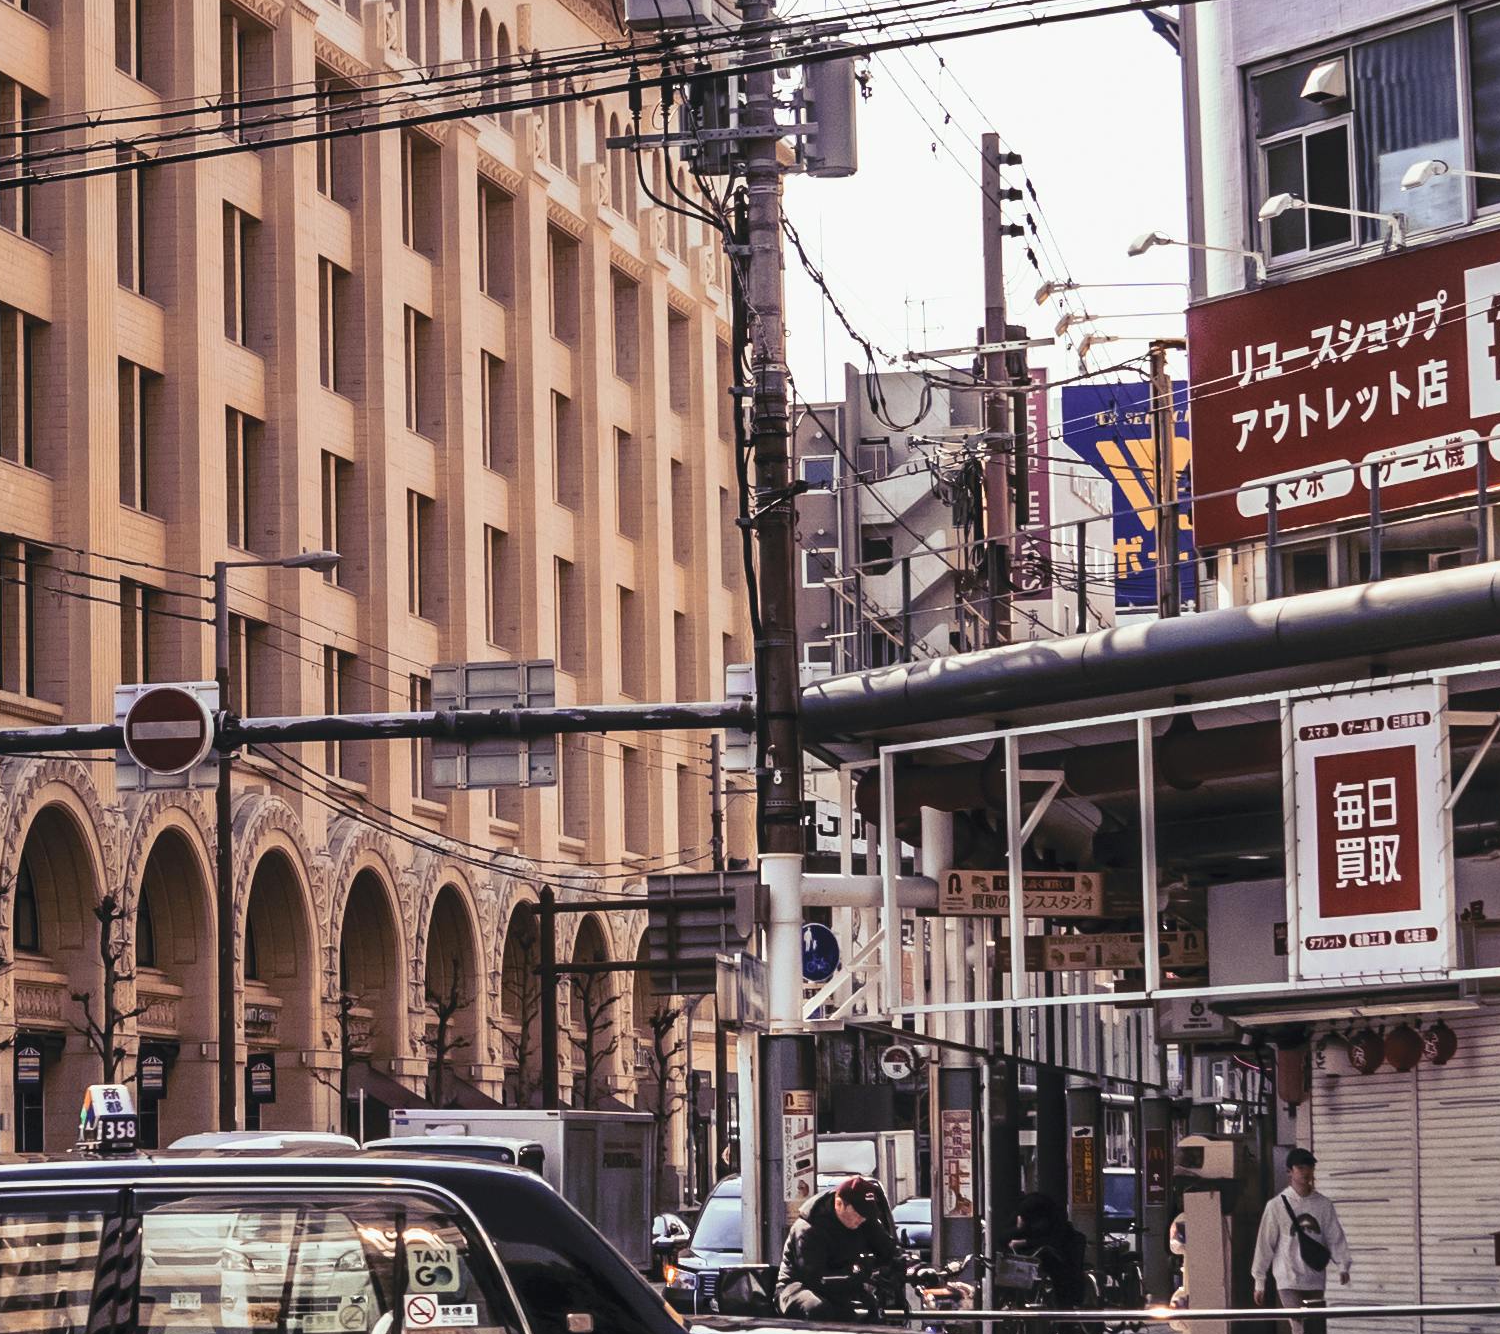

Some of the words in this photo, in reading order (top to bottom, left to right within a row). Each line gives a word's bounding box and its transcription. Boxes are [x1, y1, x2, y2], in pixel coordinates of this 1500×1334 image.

[1232, 359, 1448, 453] アウトレット店
[1333, 777, 1397, 831] 毎日
[1336, 835, 1401, 888] 買取
[972, 893, 1095, 910] 買取のンススタジオ
[106, 1121, 136, 1139] 358
[413, 1250, 450, 1263] TAXI
[415, 1266, 453, 1286] GO
